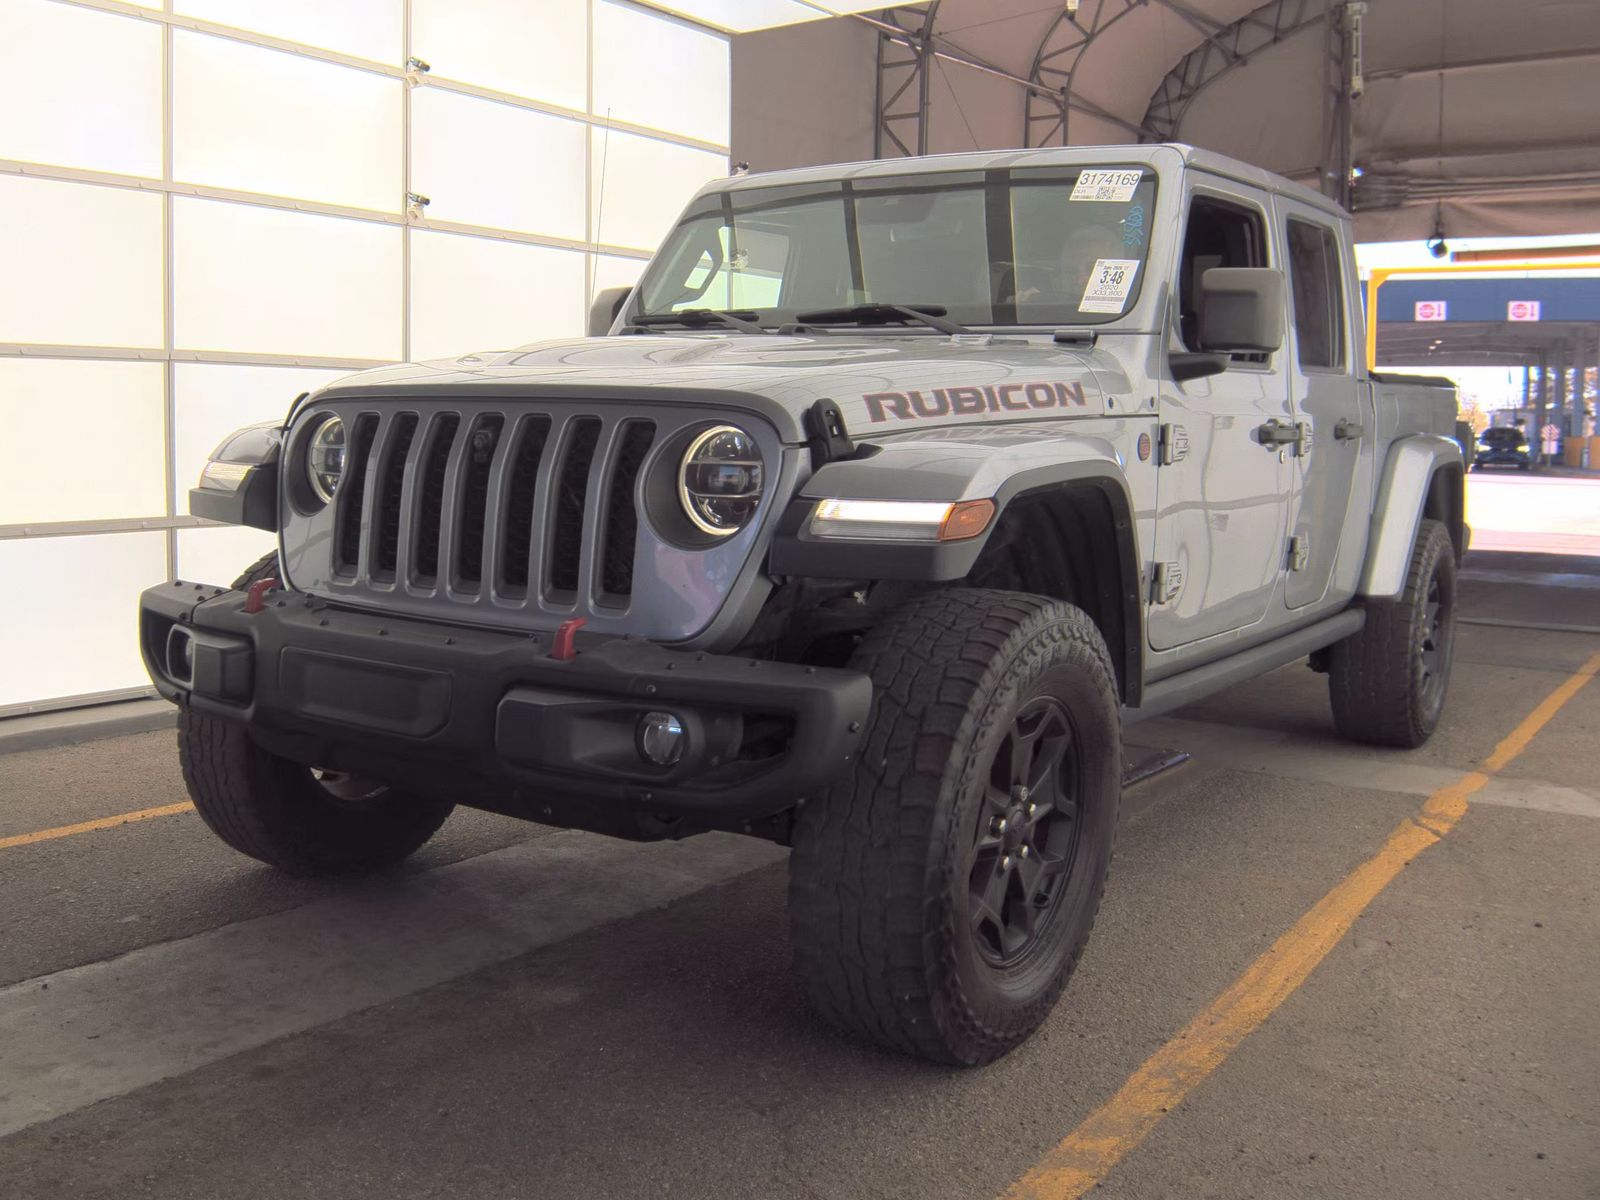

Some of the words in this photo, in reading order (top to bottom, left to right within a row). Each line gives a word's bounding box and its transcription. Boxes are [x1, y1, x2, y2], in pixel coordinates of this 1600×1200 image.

[1080, 173, 1140, 186] 3174169
[1100, 270, 1125, 285] 3:48
[862, 381, 1088, 423] RUBICON
